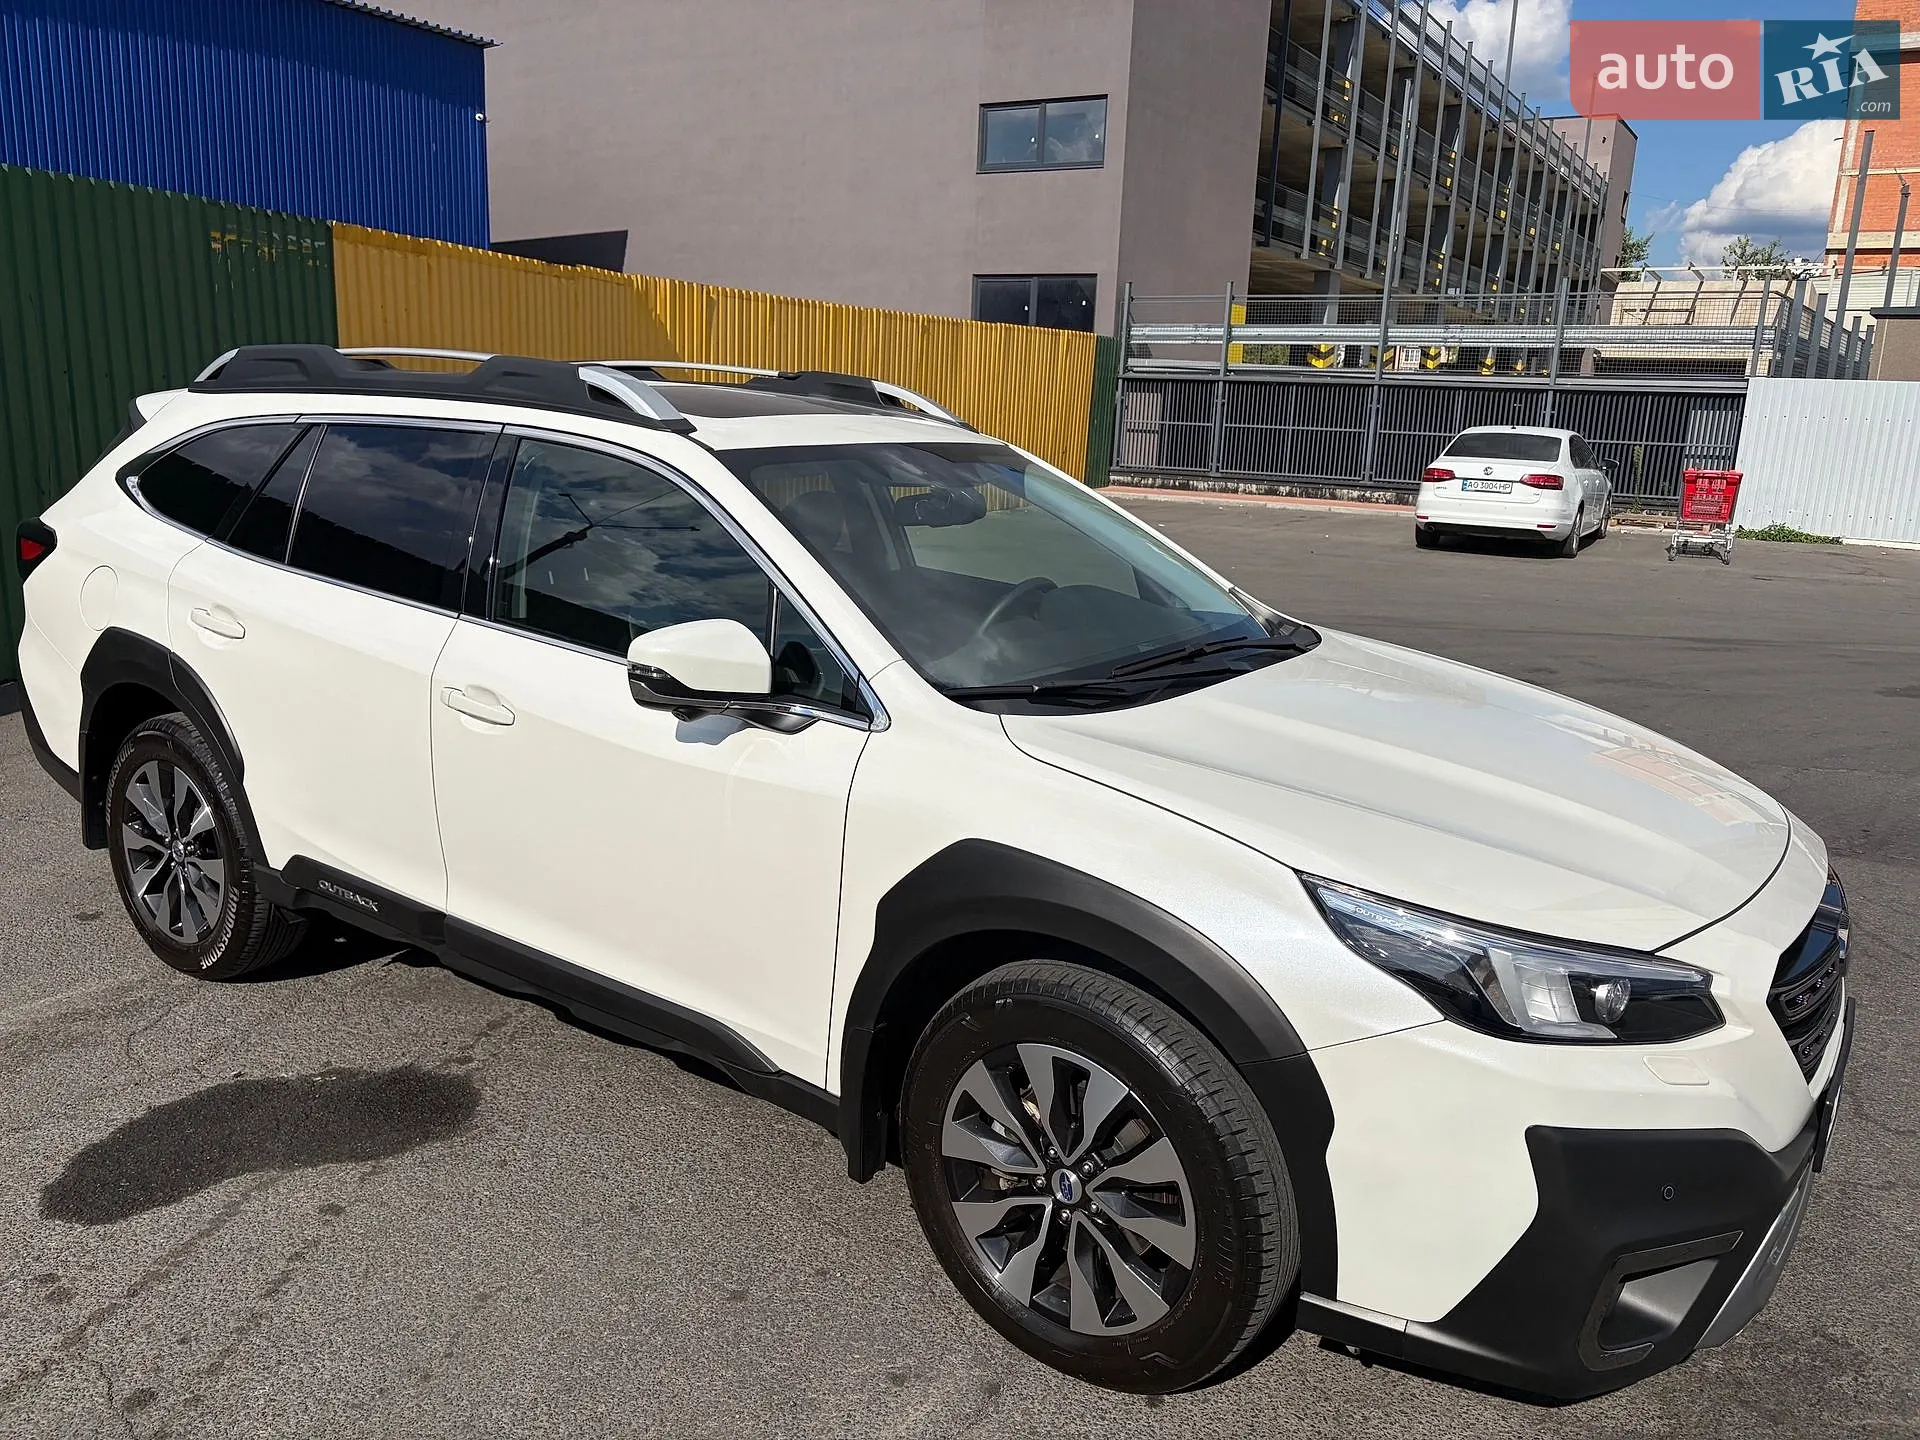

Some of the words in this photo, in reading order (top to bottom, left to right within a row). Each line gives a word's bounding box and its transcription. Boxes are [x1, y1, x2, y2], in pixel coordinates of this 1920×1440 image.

[318, 880, 378, 912] OUTBACK
[200, 884, 240, 969] BRIDGESTONE
[1355, 907, 1404, 928] OUTBACK
